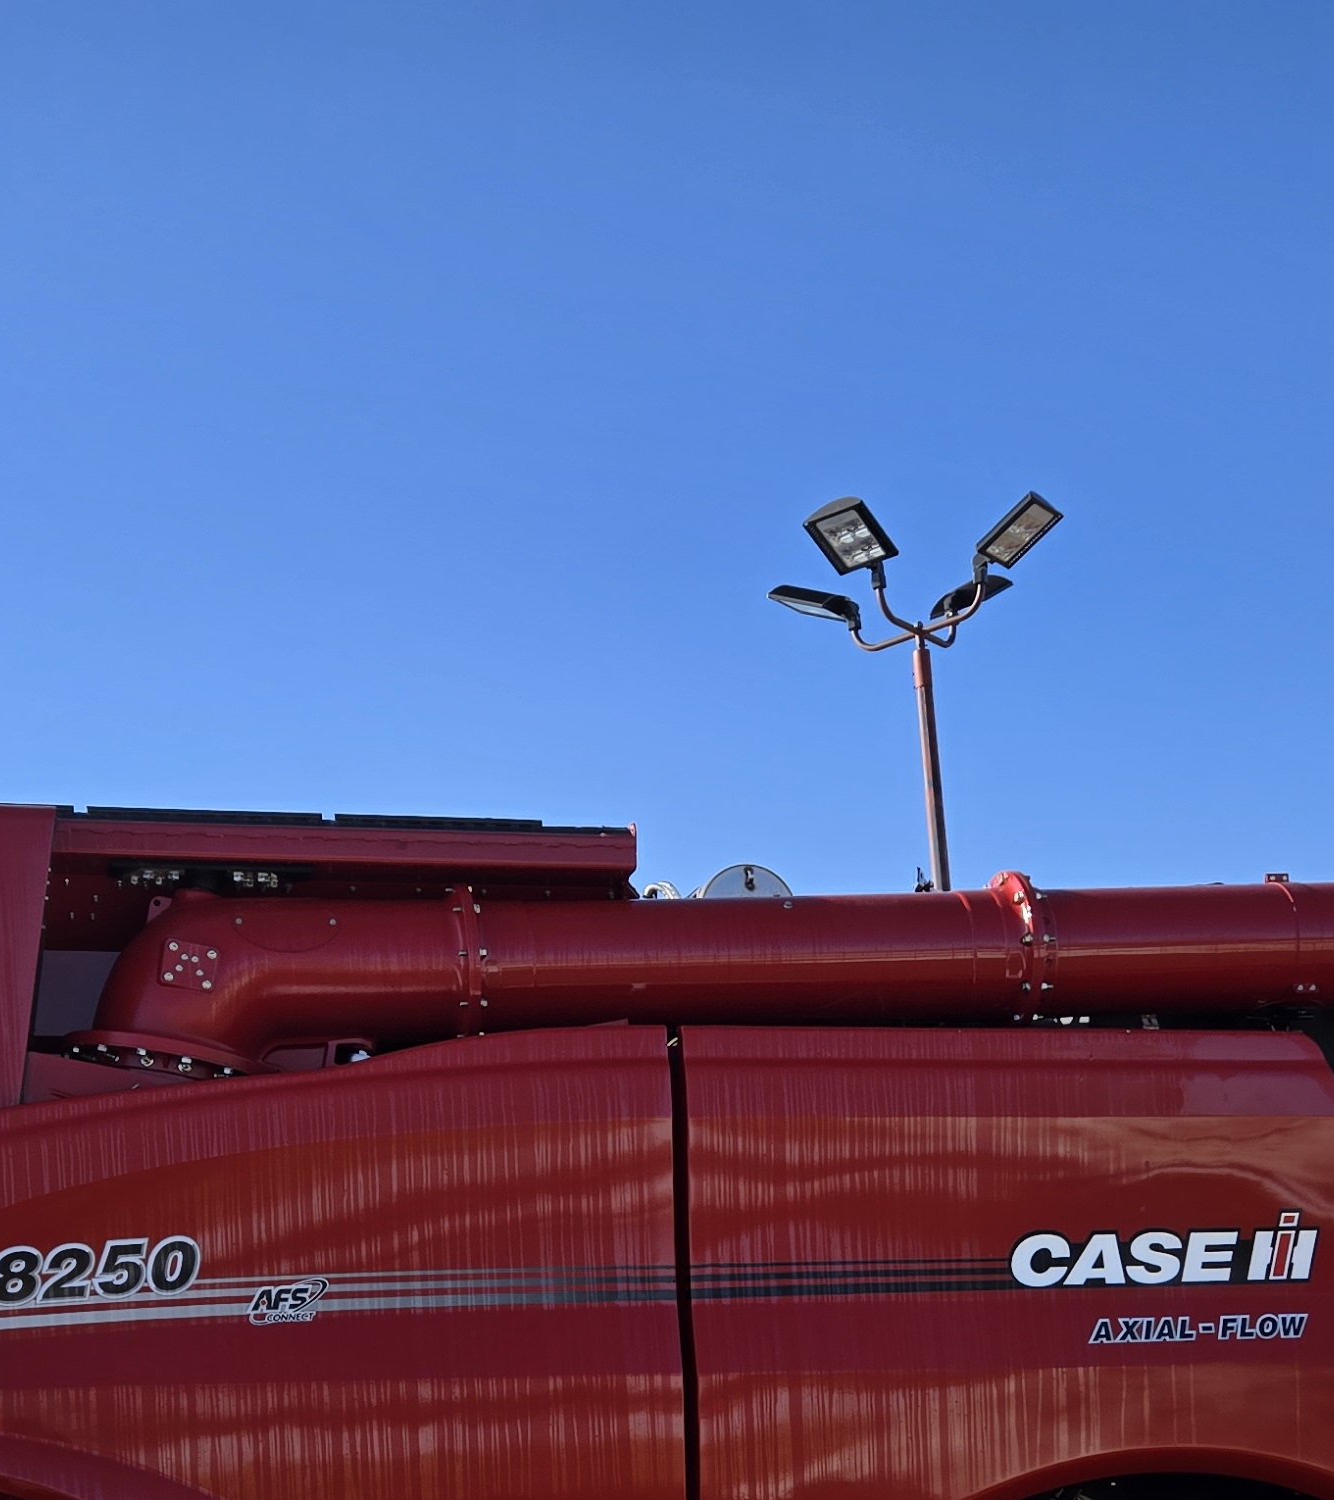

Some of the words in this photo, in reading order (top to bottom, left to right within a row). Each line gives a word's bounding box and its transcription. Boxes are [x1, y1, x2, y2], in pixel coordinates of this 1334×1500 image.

[1011, 1231, 1240, 1288] CASE
[249, 1285, 313, 1312] AFS
[266, 1312, 315, 1322] CONNECT
[1088, 1313, 1309, 1344] AXIAL-FLOW
